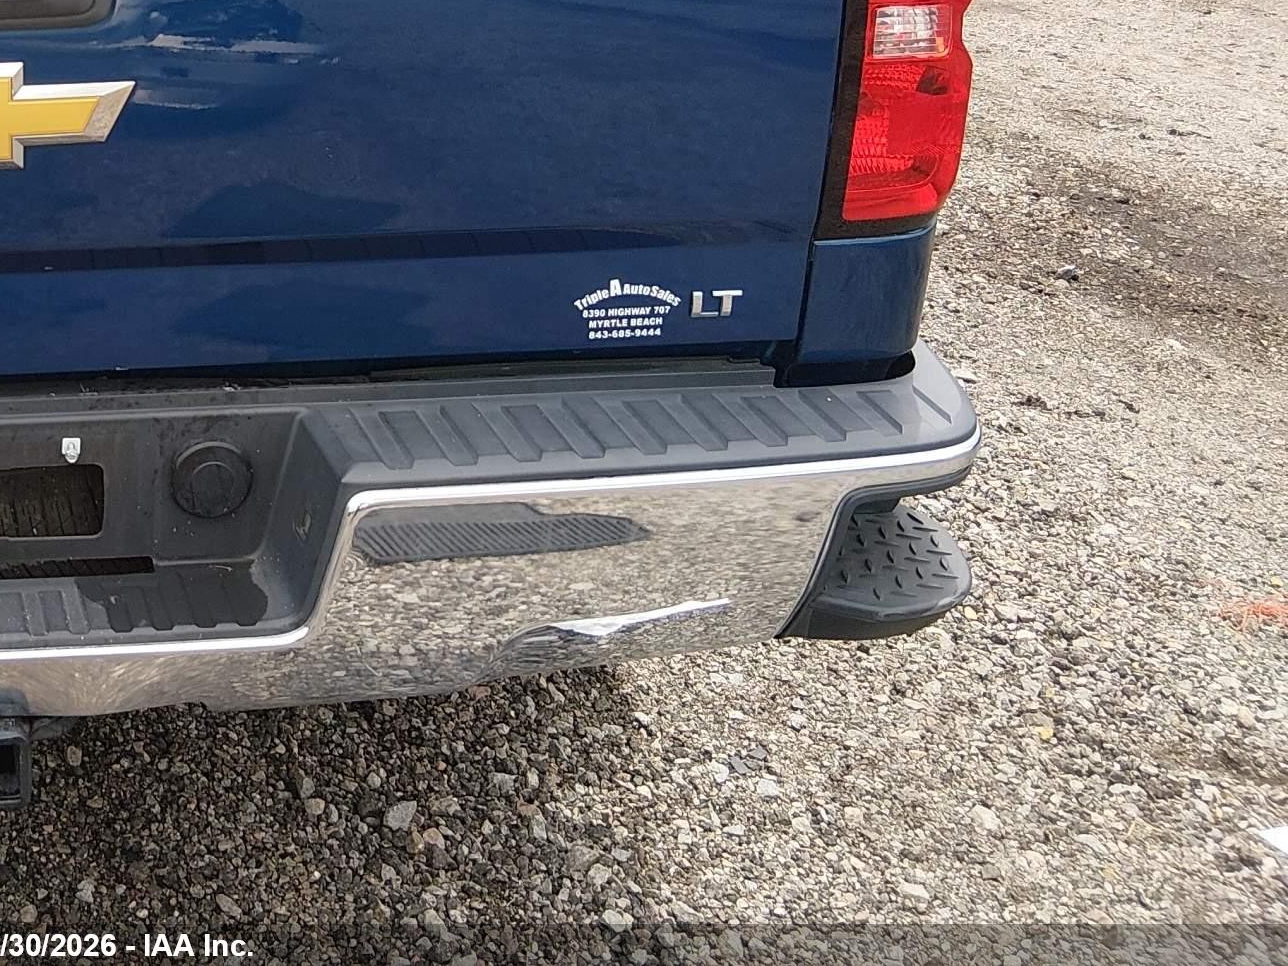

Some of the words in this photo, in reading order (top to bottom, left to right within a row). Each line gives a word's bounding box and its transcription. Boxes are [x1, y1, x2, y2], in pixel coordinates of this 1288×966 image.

[573, 288, 610, 311] Triple
[609, 278, 622, 297] A
[690, 289, 744, 318] LT
[607, 306, 652, 317] HIGHWAY
[653, 305, 671, 315] 707
[588, 318, 628, 329] MYRTLE
[630, 316, 663, 327] BEACH
